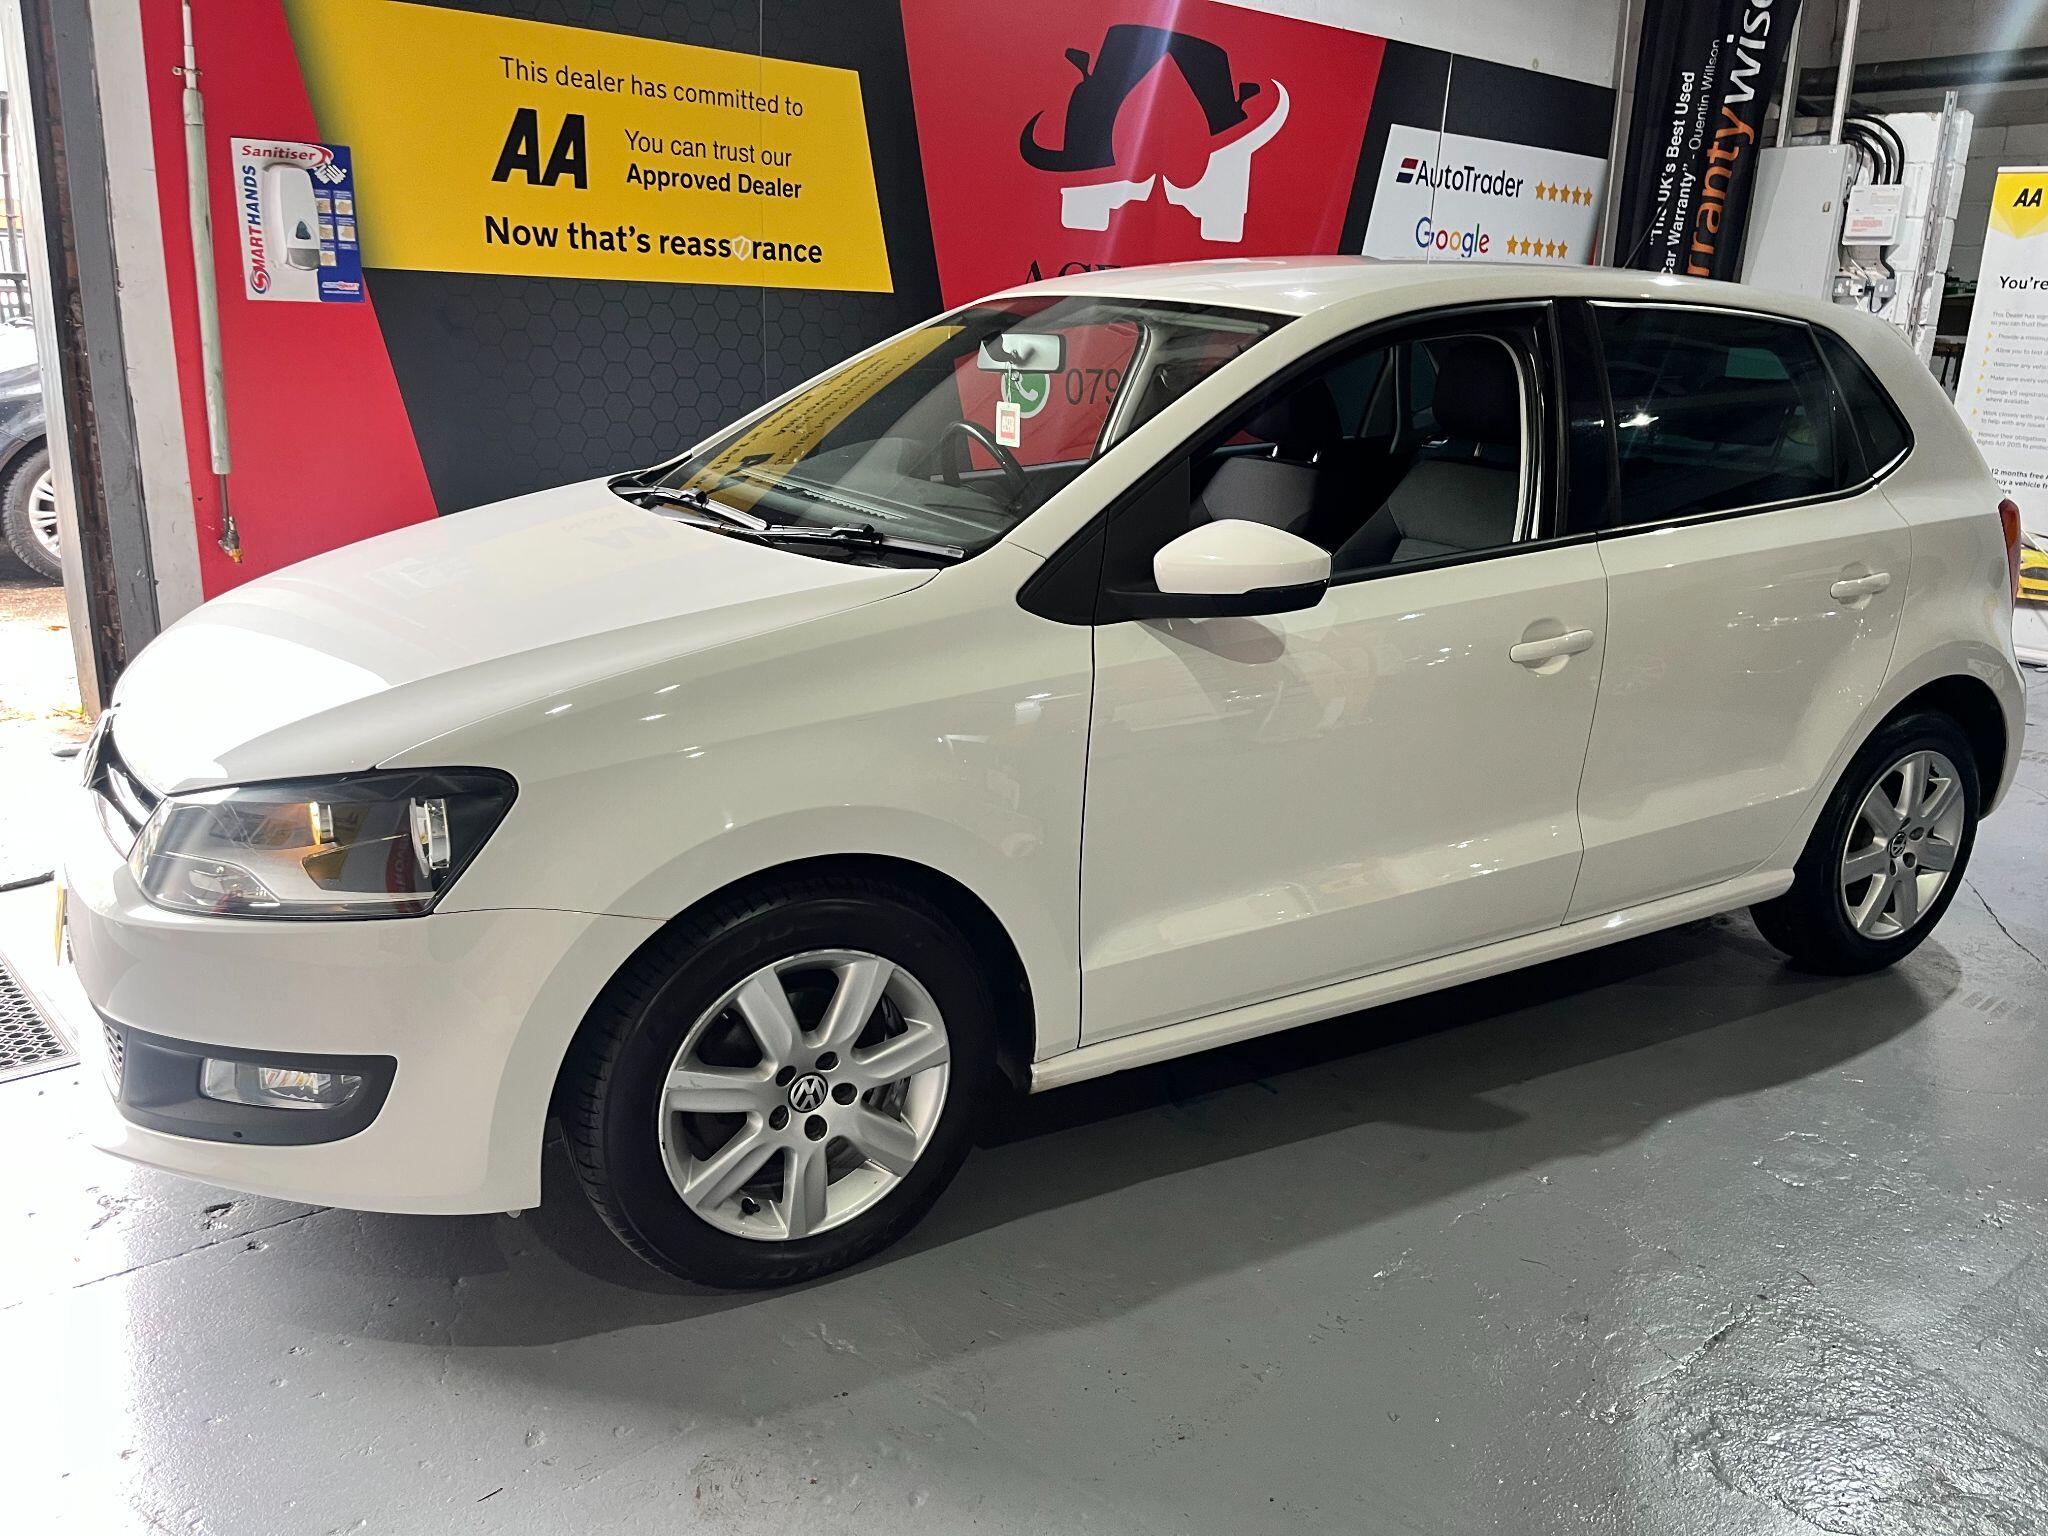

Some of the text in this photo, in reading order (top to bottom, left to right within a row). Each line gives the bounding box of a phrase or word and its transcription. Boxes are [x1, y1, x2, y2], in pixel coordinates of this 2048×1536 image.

[1700, 39, 1720, 92] Willson
[499, 56, 803, 116] This dealer has committed to
[1674, 71, 1695, 116] Used
[1666, 119, 1686, 158] Best
[1688, 93, 1710, 151] Quentin
[241, 145, 317, 161] Sanitiser
[491, 107, 588, 190] AA
[624, 129, 792, 167] You can trust our
[626, 163, 802, 198] Approved Dealer
[1415, 160, 1524, 198] AutoTrader
[1658, 163, 1676, 204] UK's
[2013, 188, 2043, 208] AA
[1666, 163, 1697, 247] Warranty"
[485, 215, 558, 248] Now
[567, 222, 652, 254] that's
[1415, 216, 1490, 258] Google
[1660, 250, 1677, 276] Car
[2000, 275, 2048, 290] You're
[2000, 470, 2028, 479] months
[2014, 480, 2041, 489] vehicle
